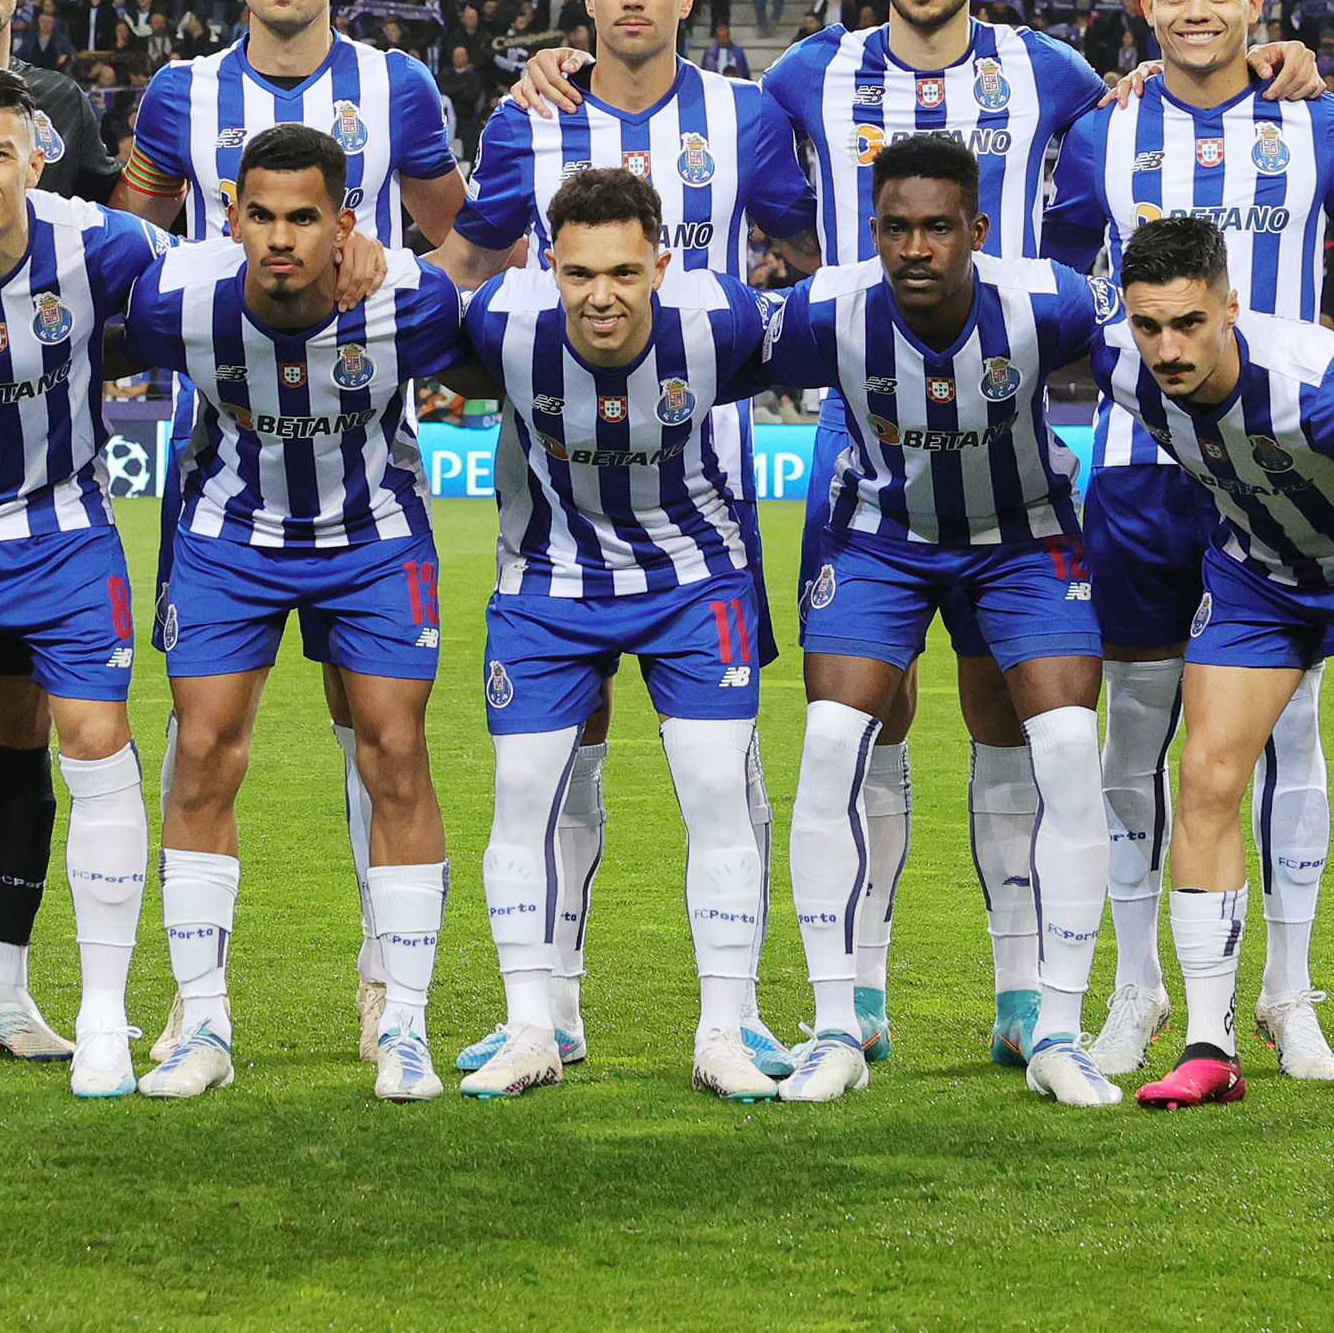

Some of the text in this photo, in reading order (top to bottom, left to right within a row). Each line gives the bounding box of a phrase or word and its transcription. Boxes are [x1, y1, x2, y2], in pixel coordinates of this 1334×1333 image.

[256, 407, 375, 439] BETANO
[903, 411, 1019, 451] BETANO
[570, 436, 690, 466] BETANO
[107, 574, 132, 640] 8
[402, 560, 439, 626] 13
[709, 599, 751, 664] 11
